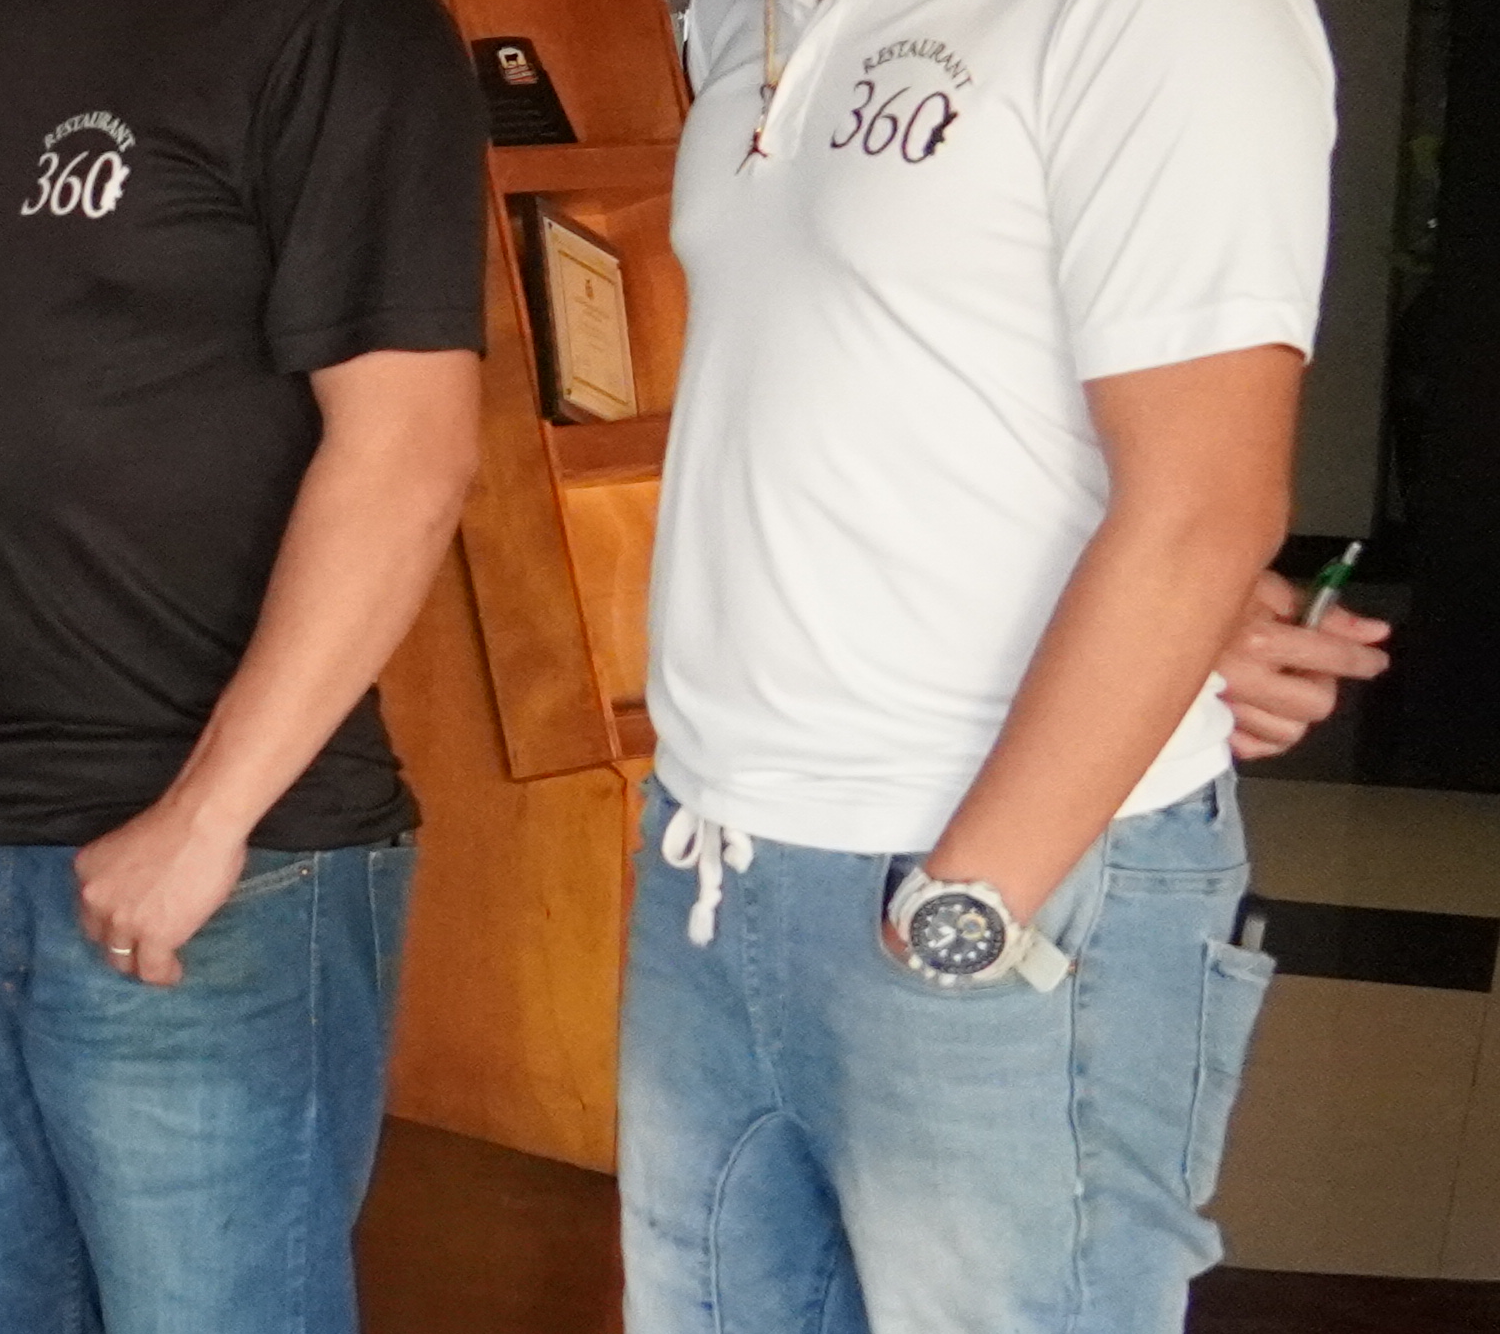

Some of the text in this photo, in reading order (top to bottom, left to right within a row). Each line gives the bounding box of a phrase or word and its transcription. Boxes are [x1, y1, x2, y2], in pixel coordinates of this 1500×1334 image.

[863, 38, 974, 89] RESTAURANT
[43, 110, 137, 153] RESTAURANT
[830, 80, 959, 164] 360
[20, 150, 131, 220] 360
